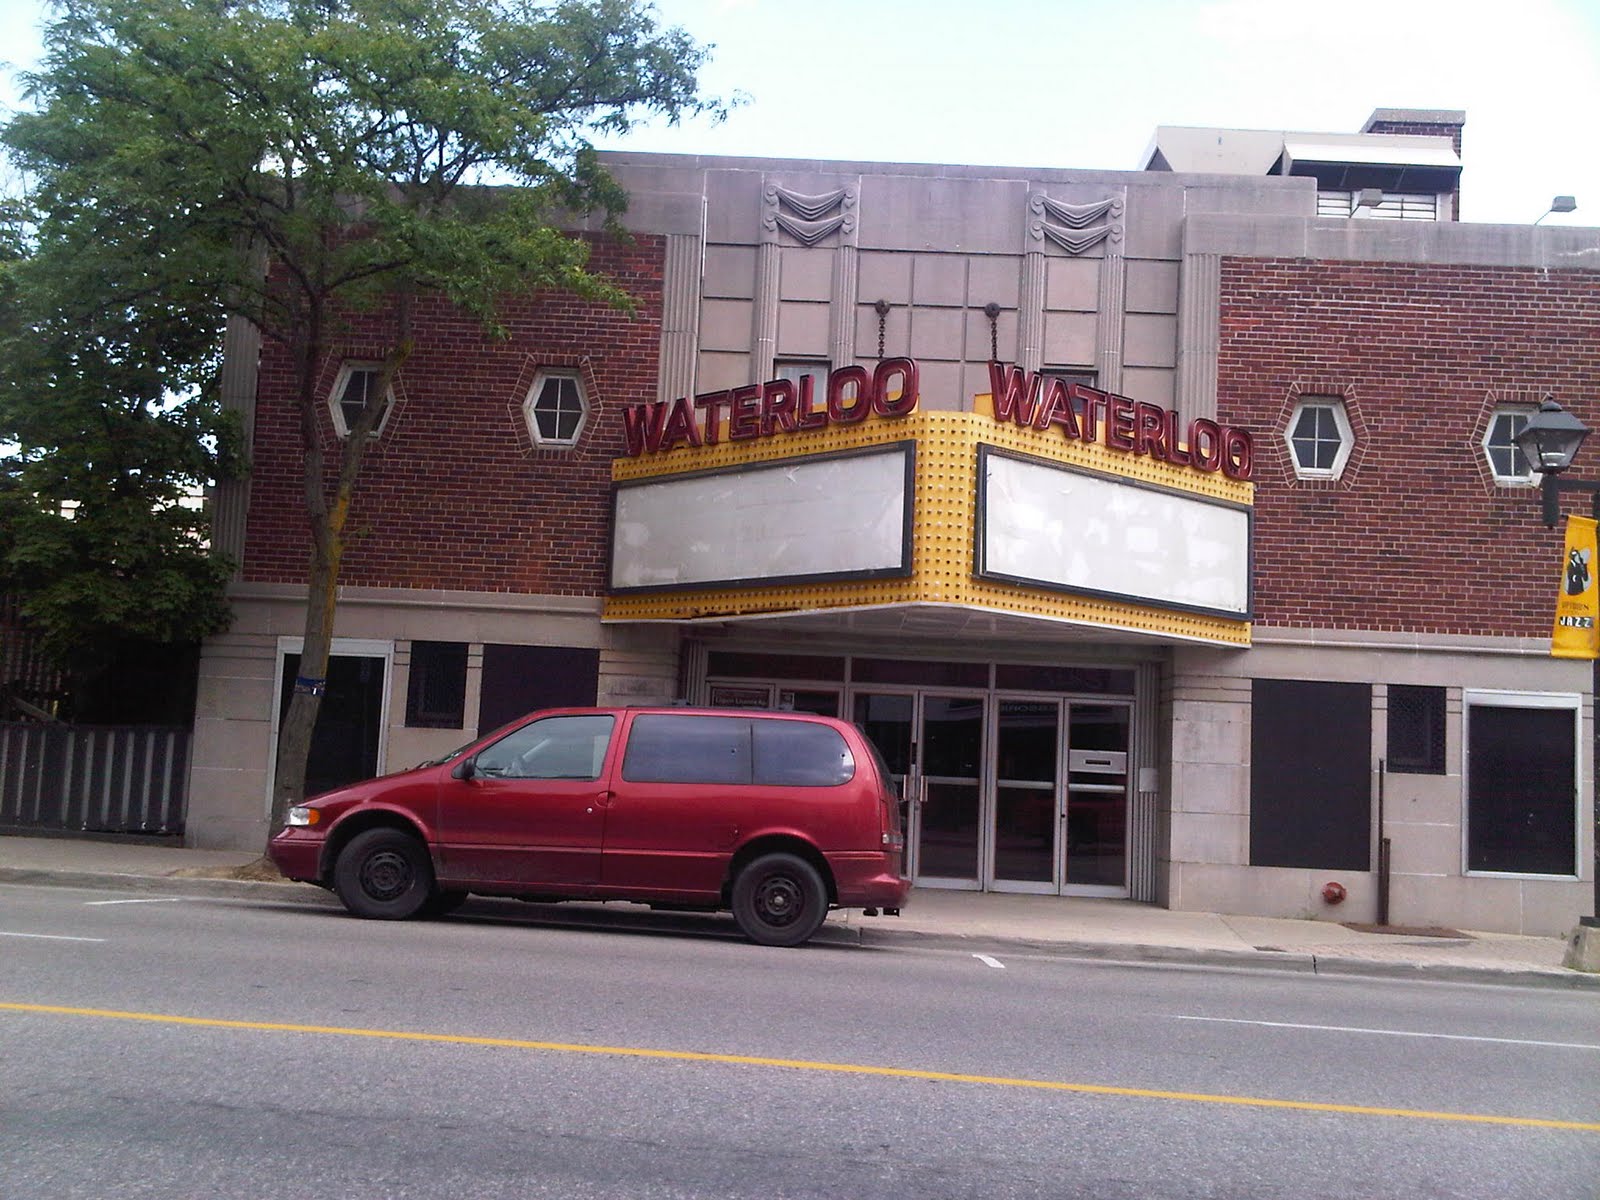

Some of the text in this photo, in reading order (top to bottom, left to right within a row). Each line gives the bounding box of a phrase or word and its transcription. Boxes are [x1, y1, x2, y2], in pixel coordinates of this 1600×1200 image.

[621, 356, 919, 457] WATERLOO
[988, 359, 1253, 480] WATERLOO
[1560, 615, 1591, 628] JAZZ
